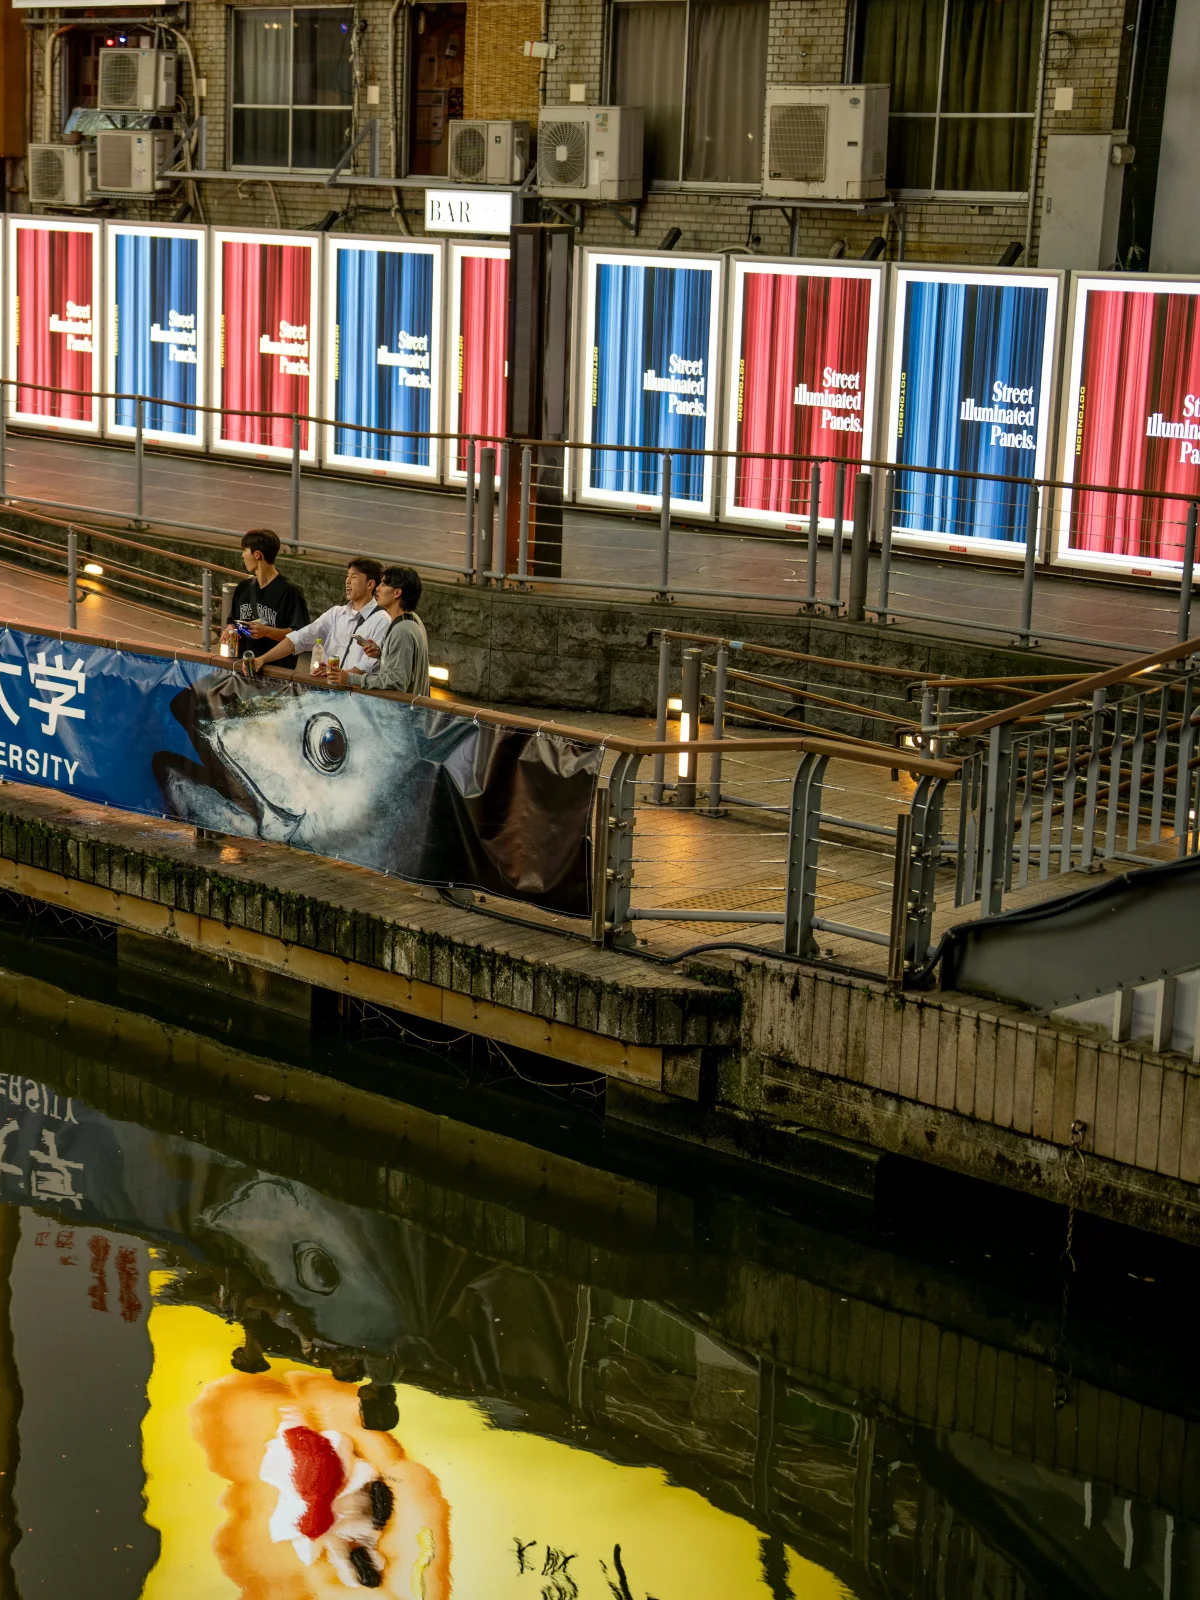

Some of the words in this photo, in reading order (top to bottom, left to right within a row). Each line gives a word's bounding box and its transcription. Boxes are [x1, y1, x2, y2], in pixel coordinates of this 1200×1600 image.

[430, 199, 470, 223] BAR
[669, 353, 704, 376] Street
[822, 366, 860, 389] Street
[737, 358, 745, 422] DOTONBORI
[992, 380, 1034, 405] Street
[668, 396, 706, 417] Panels.
[897, 371, 907, 439] DOTONBORI
[821, 409, 863, 433] Panels.
[1075, 385, 1086, 455] DOTONBORI
[989, 425, 1037, 450] Panels.
